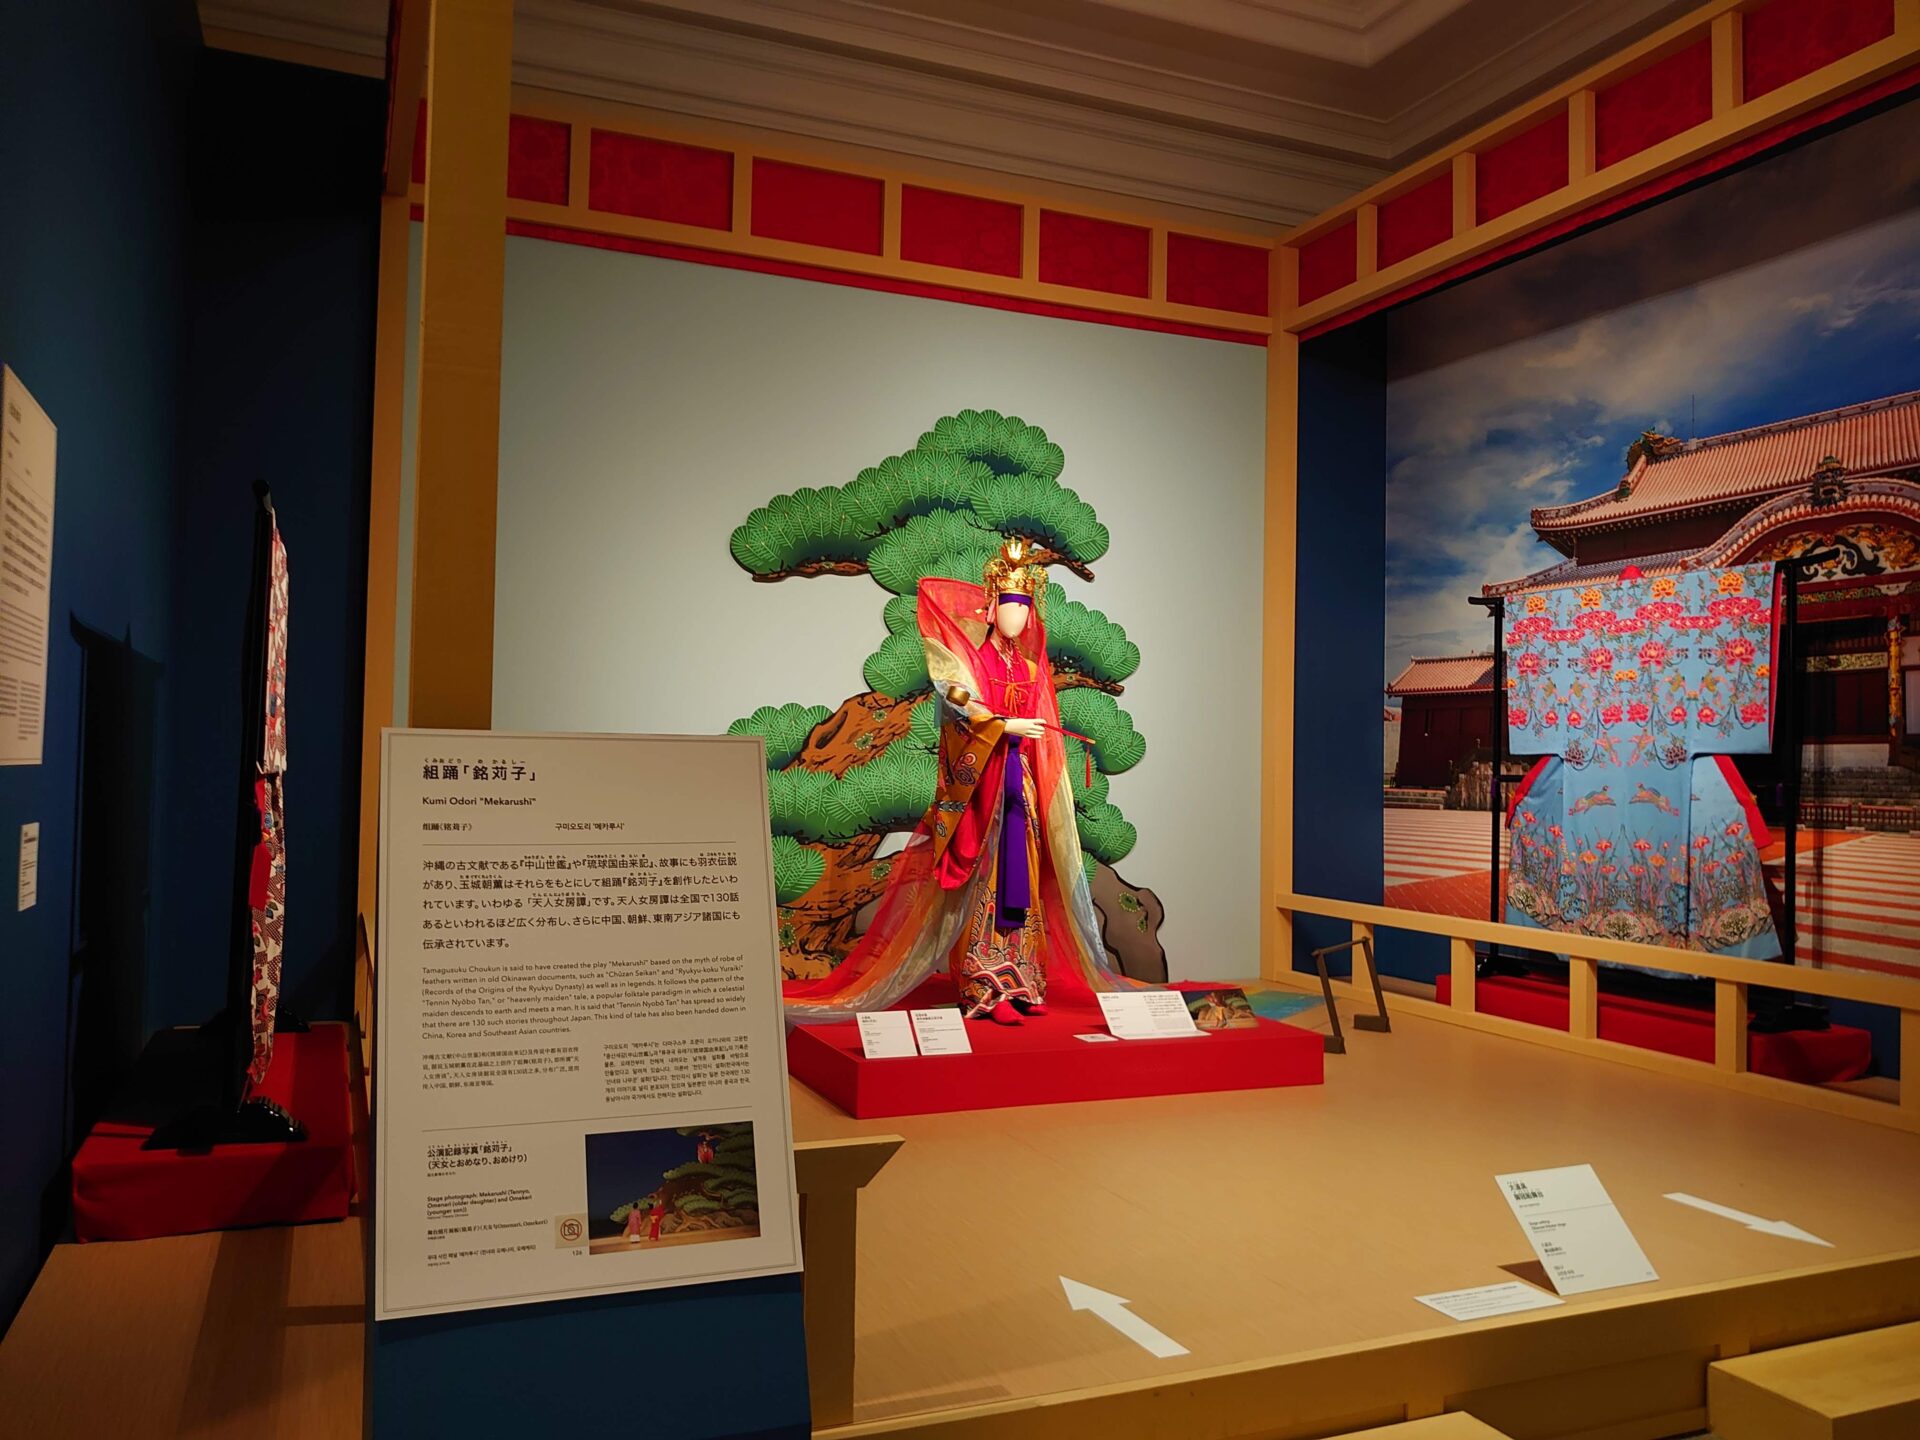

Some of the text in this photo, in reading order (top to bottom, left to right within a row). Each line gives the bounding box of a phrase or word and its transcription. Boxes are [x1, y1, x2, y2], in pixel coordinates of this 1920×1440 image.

[422, 764, 535, 781] 組踊「銘苅子」
[422, 796, 447, 805] Kumi
[449, 796, 477, 806] Odori
[555, 822, 591, 831] 구미오도리
[422, 910, 740, 929] あるといわれるほど広く分布し、さらに中国、朝鮮、東南アジア諸国にも
[422, 937, 511, 950] 伝承されています。
[422, 966, 467, 975] Tamagusuku
[552, 962, 578, 970] created
[592, 961, 607, 969] play
[694, 956, 710, 964] myth
[711, 955, 718, 963] of
[421, 988, 454, 996] (Records
[478, 986, 505, 994] Origins
[529, 984, 553, 993] Ryukyu
[555, 983, 585, 992] Dynasty)
[627, 979, 656, 988] legends.
[507, 995, 541, 1003] "heavenly
[596, 992, 623, 1000] popular
[651, 989, 683, 997] paradigm
[692, 986, 711, 994] which
[718, 984, 745, 992] celestial
[450, 1008, 484, 1016] descends
[513, 1006, 527, 1014] and
[693, 996, 715, 1005] spread
[725, 995, 745, 1003] widely
[530, 1016, 569, 1024] throughout
[570, 1015, 592, 1023] Japan.
[422, 1032, 444, 1040] China,
[483, 1029, 517, 1037] Southeast
[470, 1198, 497, 1206] daughter)
